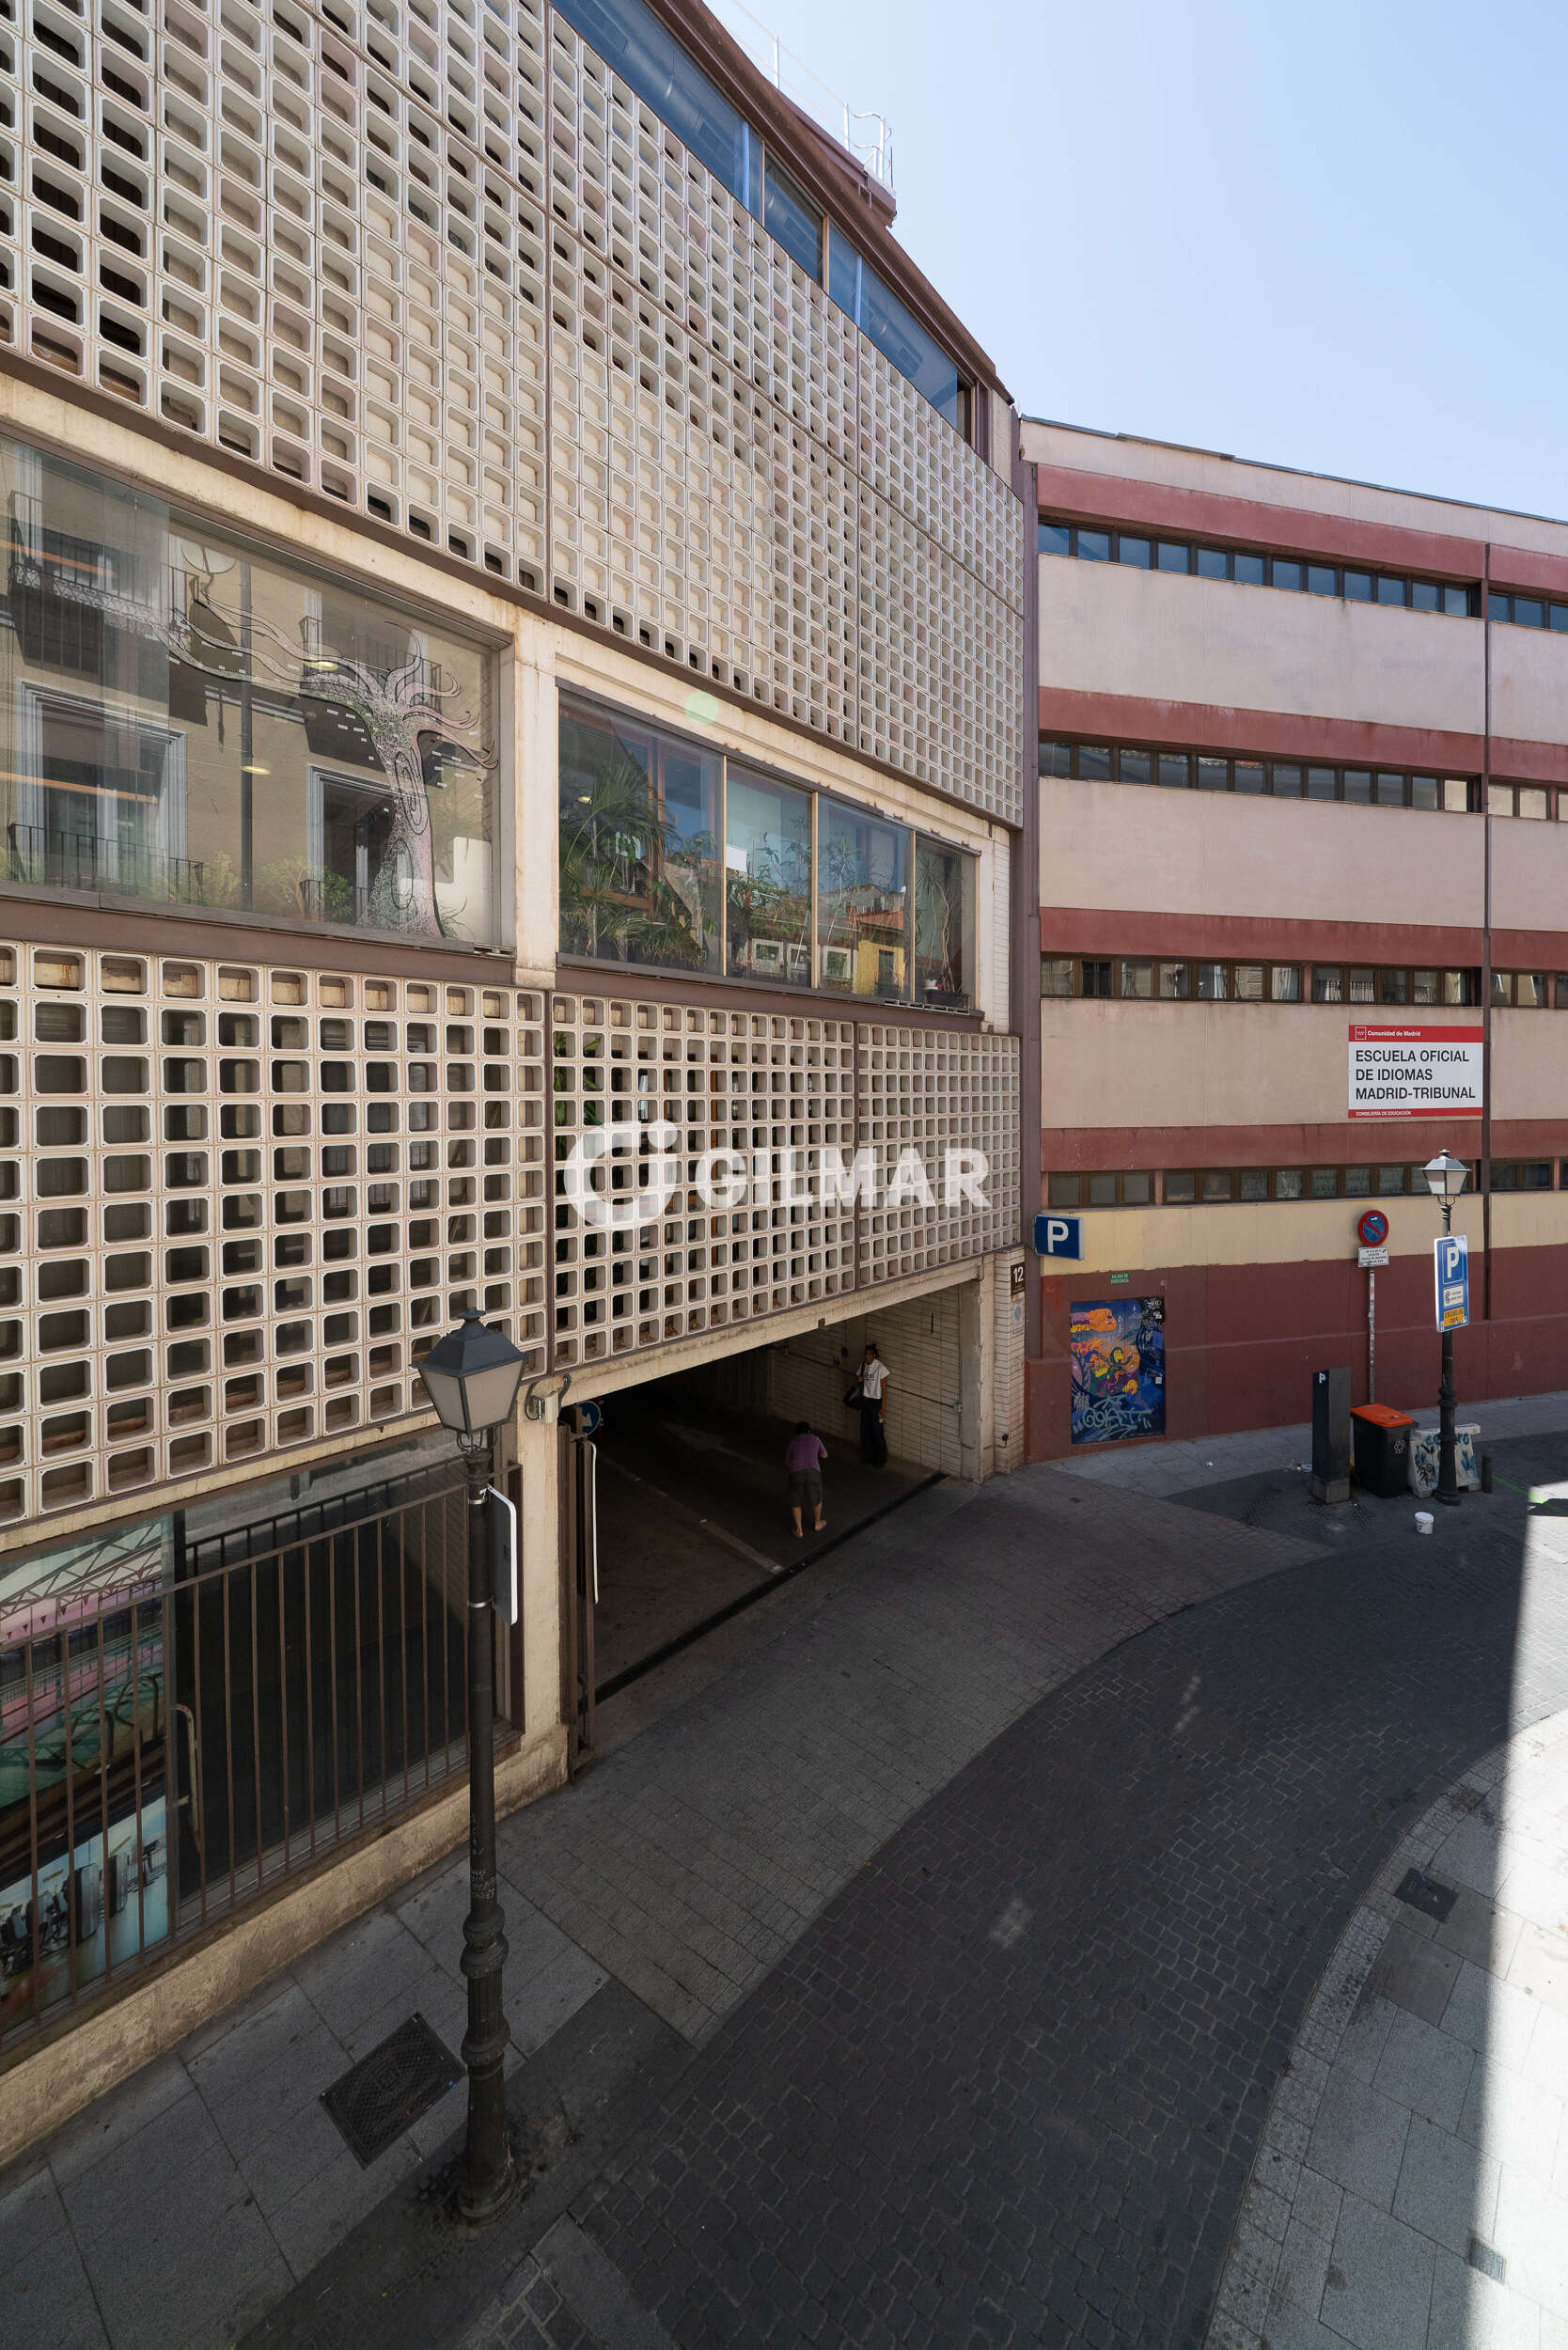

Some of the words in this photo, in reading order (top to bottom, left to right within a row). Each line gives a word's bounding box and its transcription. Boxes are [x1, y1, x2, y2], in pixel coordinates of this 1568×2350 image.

[1356, 1050, 1416, 1062] ESCUELA
[1419, 1050, 1469, 1062] OFICIAL
[1356, 1069, 1373, 1081] DE
[1378, 1069, 1433, 1081] IDIOMAS
[1356, 1087, 1476, 1100] MADRID-TRIBUNAL
[1047, 1220, 1069, 1253] P
[1447, 1246, 1459, 1278] P
[1013, 1266, 1024, 1283] 12
[1318, 1372, 1326, 1384] P
